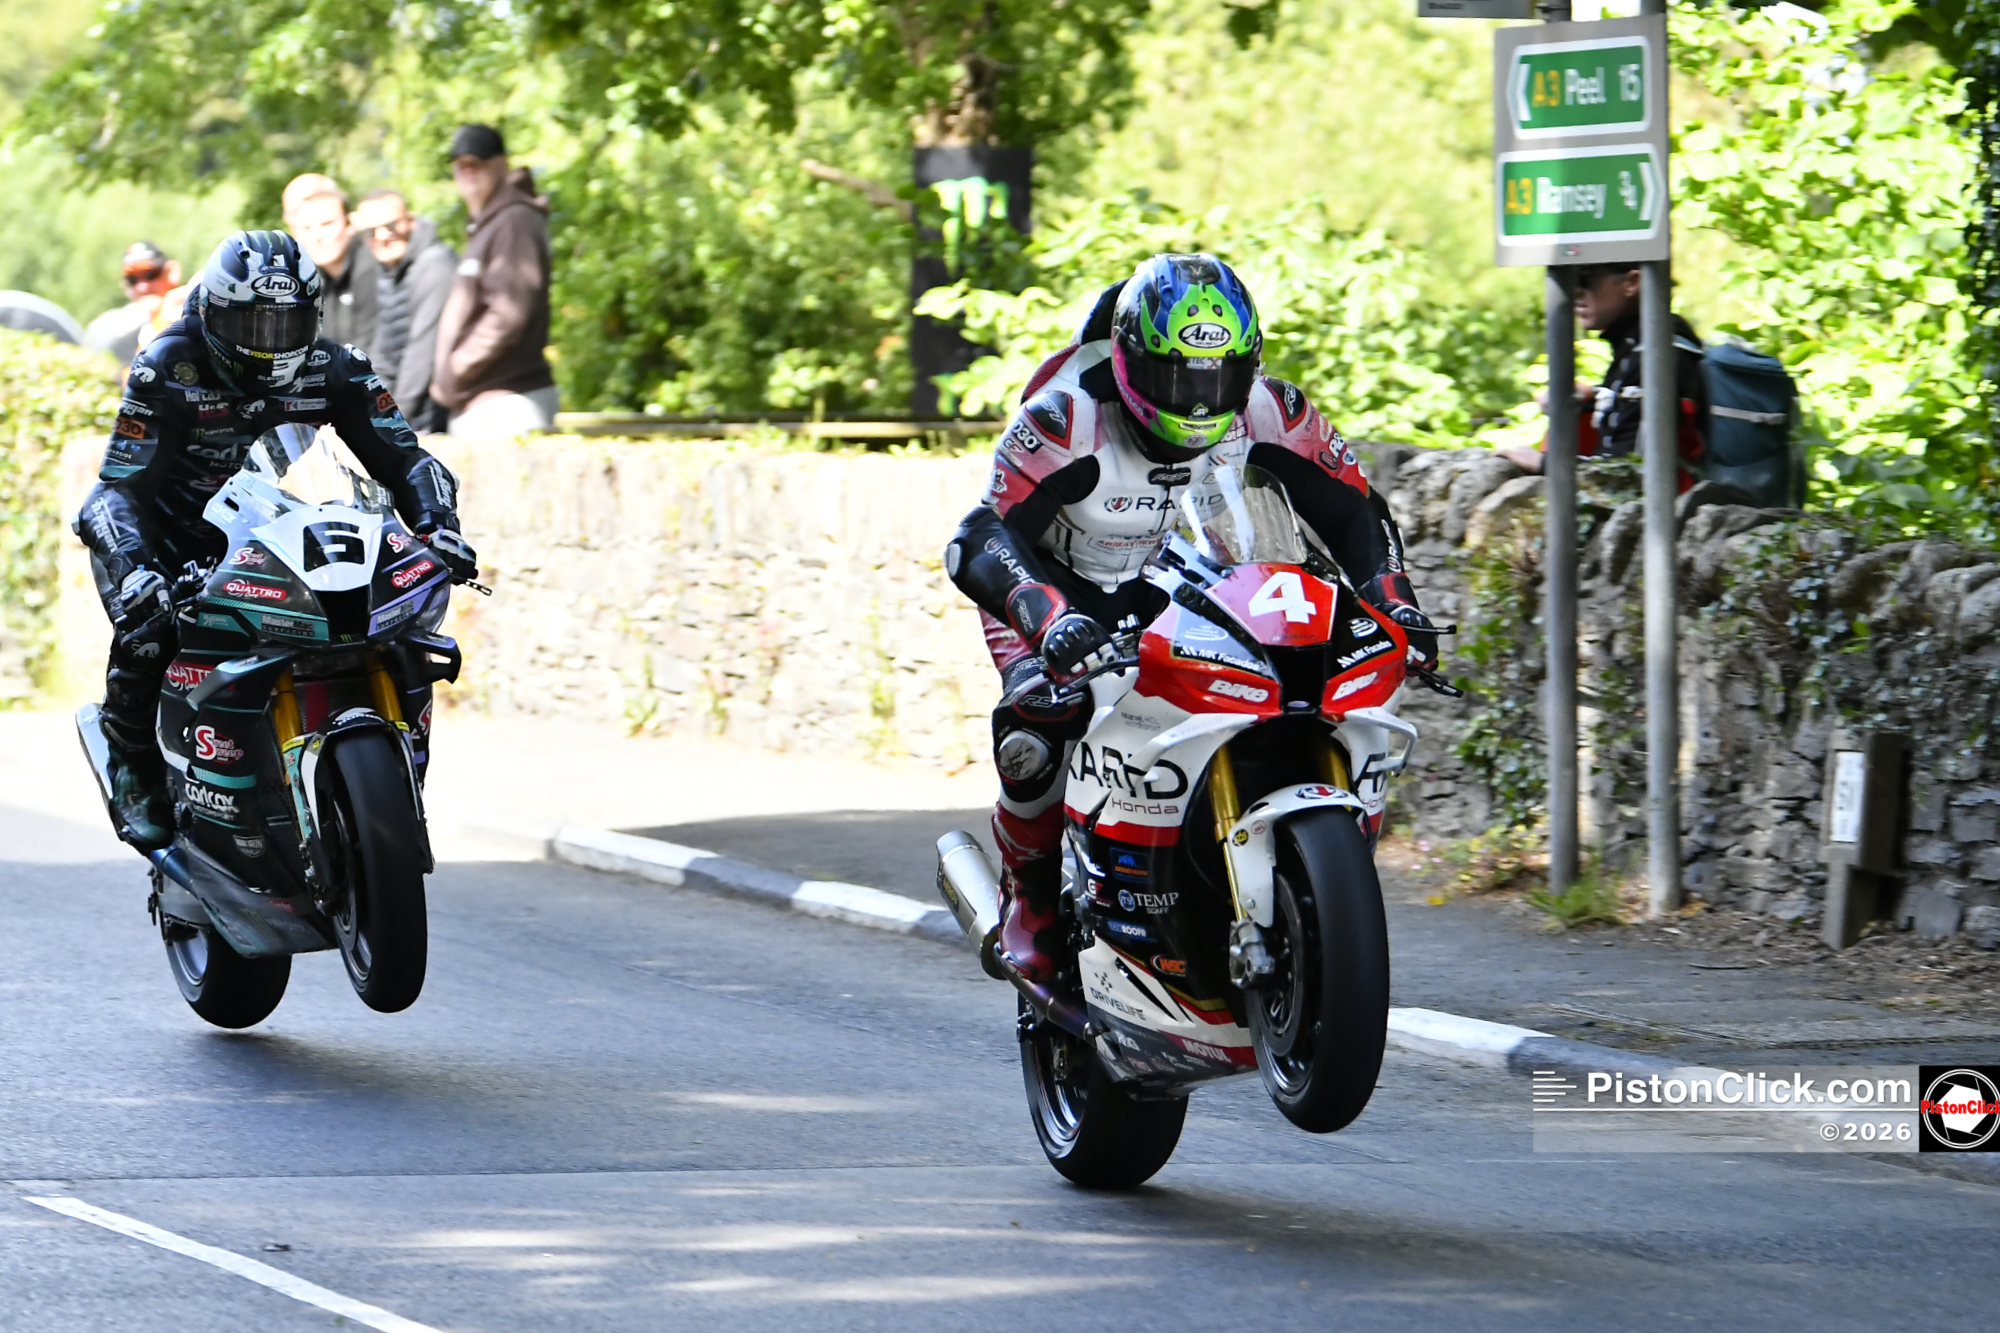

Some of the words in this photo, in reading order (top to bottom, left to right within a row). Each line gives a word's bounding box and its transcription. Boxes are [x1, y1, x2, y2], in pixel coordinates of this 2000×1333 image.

[1532, 70, 1561, 107] A3
[1564, 66, 1607, 105] Peel
[1618, 63, 1642, 101] 15
[1505, 177, 1533, 214] A3
[1536, 176, 1607, 219] Ramsey
[1184, 325, 1226, 341] Arai
[303, 521, 366, 573] 6
[394, 562, 432, 586] QUATTRO
[226, 582, 282, 598] QUATTRO
[1248, 571, 1317, 624] 4
[1208, 680, 1269, 702] Bike
[1111, 799, 1179, 814] Honda
[1133, 892, 1179, 907] TEMP
[1090, 986, 1146, 1021] DRIVELIFE
[1181, 1039, 1232, 1063] MOTUL
